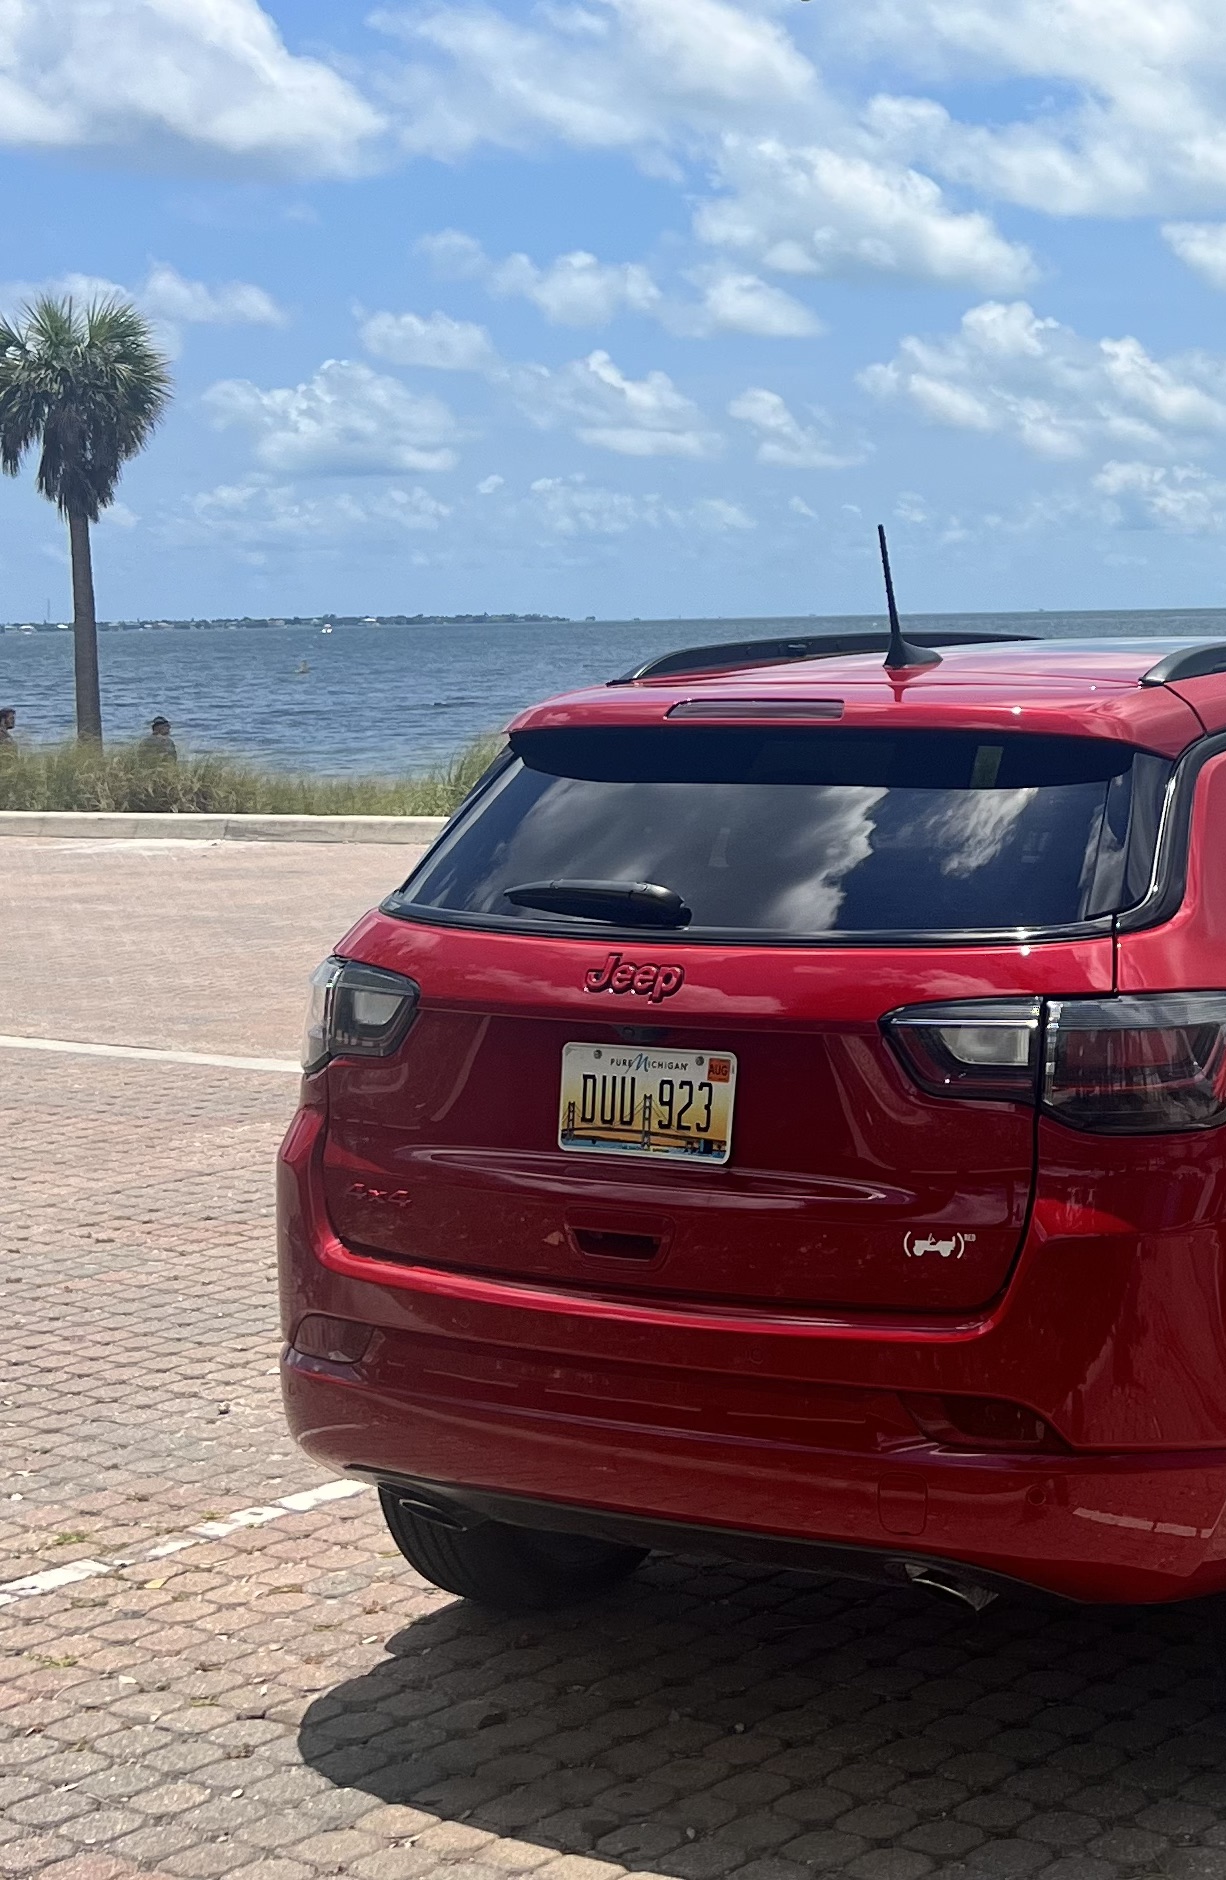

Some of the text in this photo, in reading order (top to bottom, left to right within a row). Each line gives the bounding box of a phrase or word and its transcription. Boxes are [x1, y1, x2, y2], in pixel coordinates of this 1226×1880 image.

[584, 952, 686, 1004] Jeep
[610, 1053, 689, 1073] PURE MICHIGAN
[708, 1064, 728, 1076] AUG
[658, 1079, 713, 1133] 923
